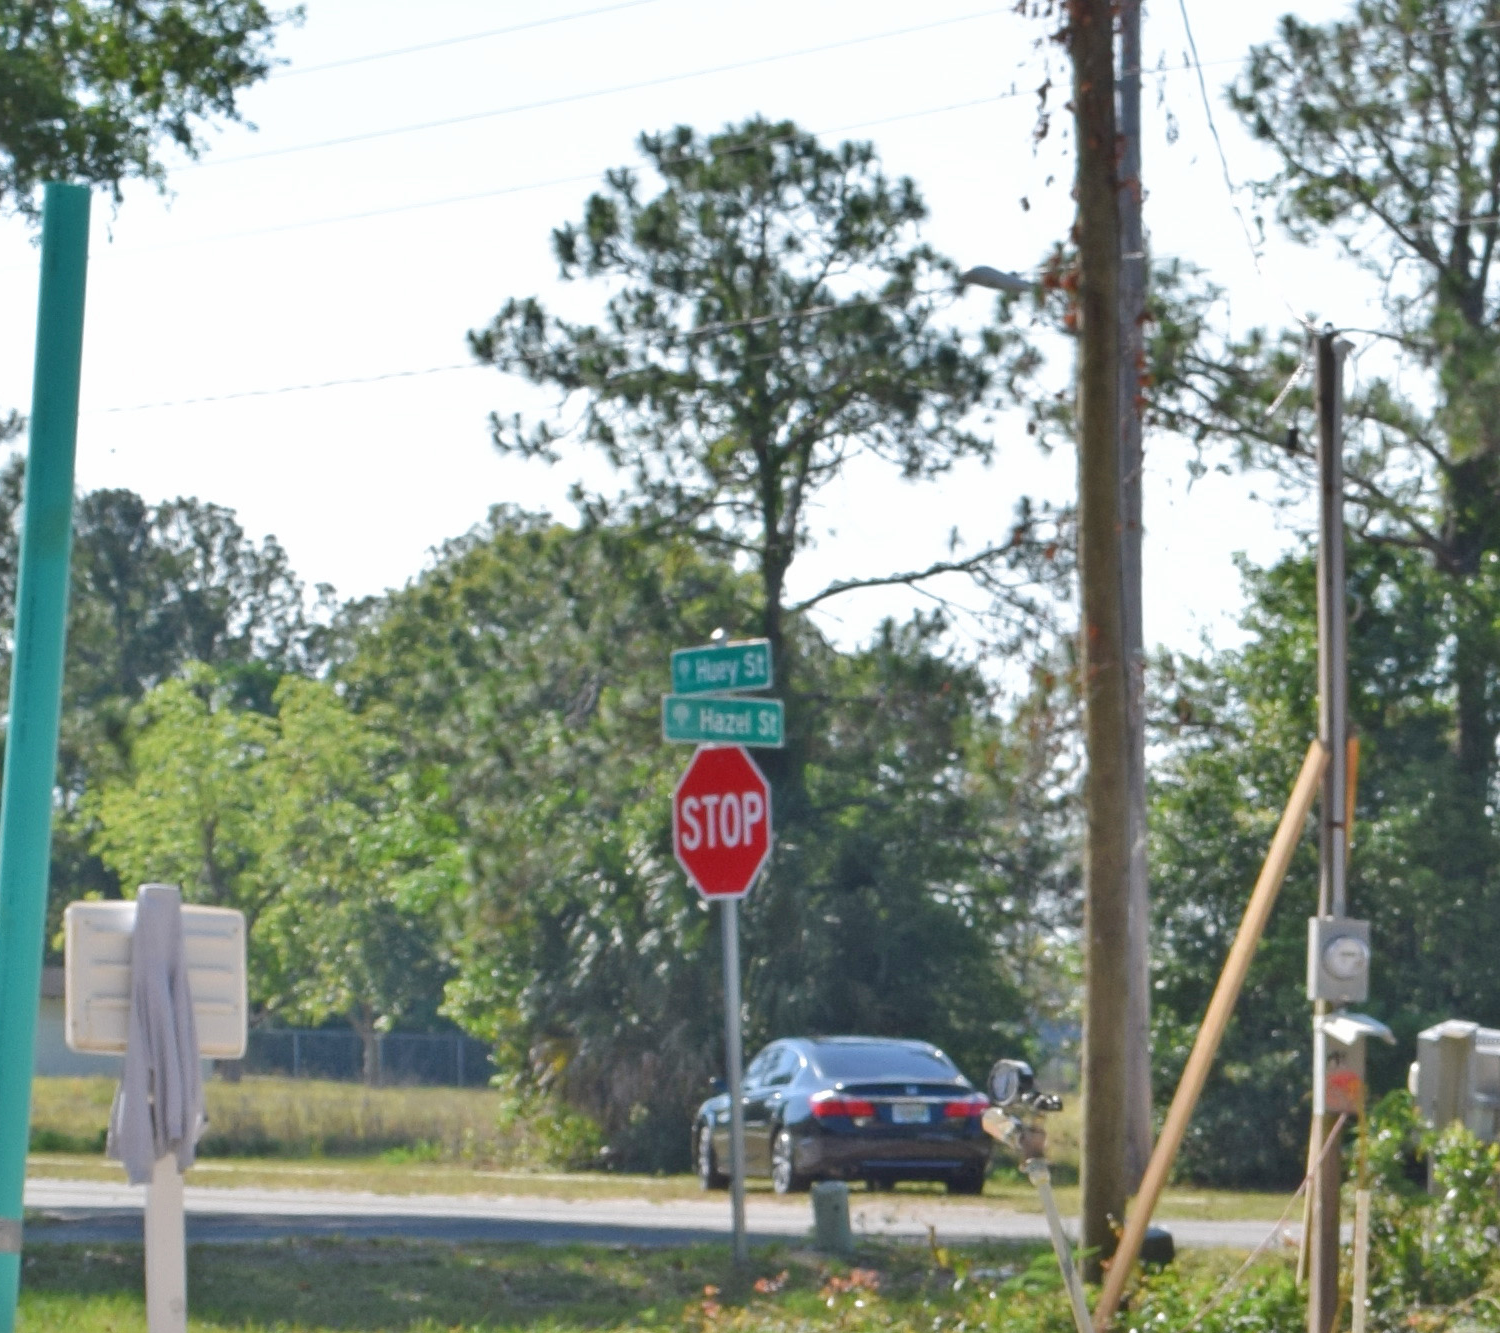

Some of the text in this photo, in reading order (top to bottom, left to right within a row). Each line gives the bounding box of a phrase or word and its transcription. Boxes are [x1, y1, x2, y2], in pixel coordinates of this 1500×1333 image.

[743, 652, 766, 678] St
[699, 709, 778, 737] Hazel St
[681, 791, 764, 851] STOP
